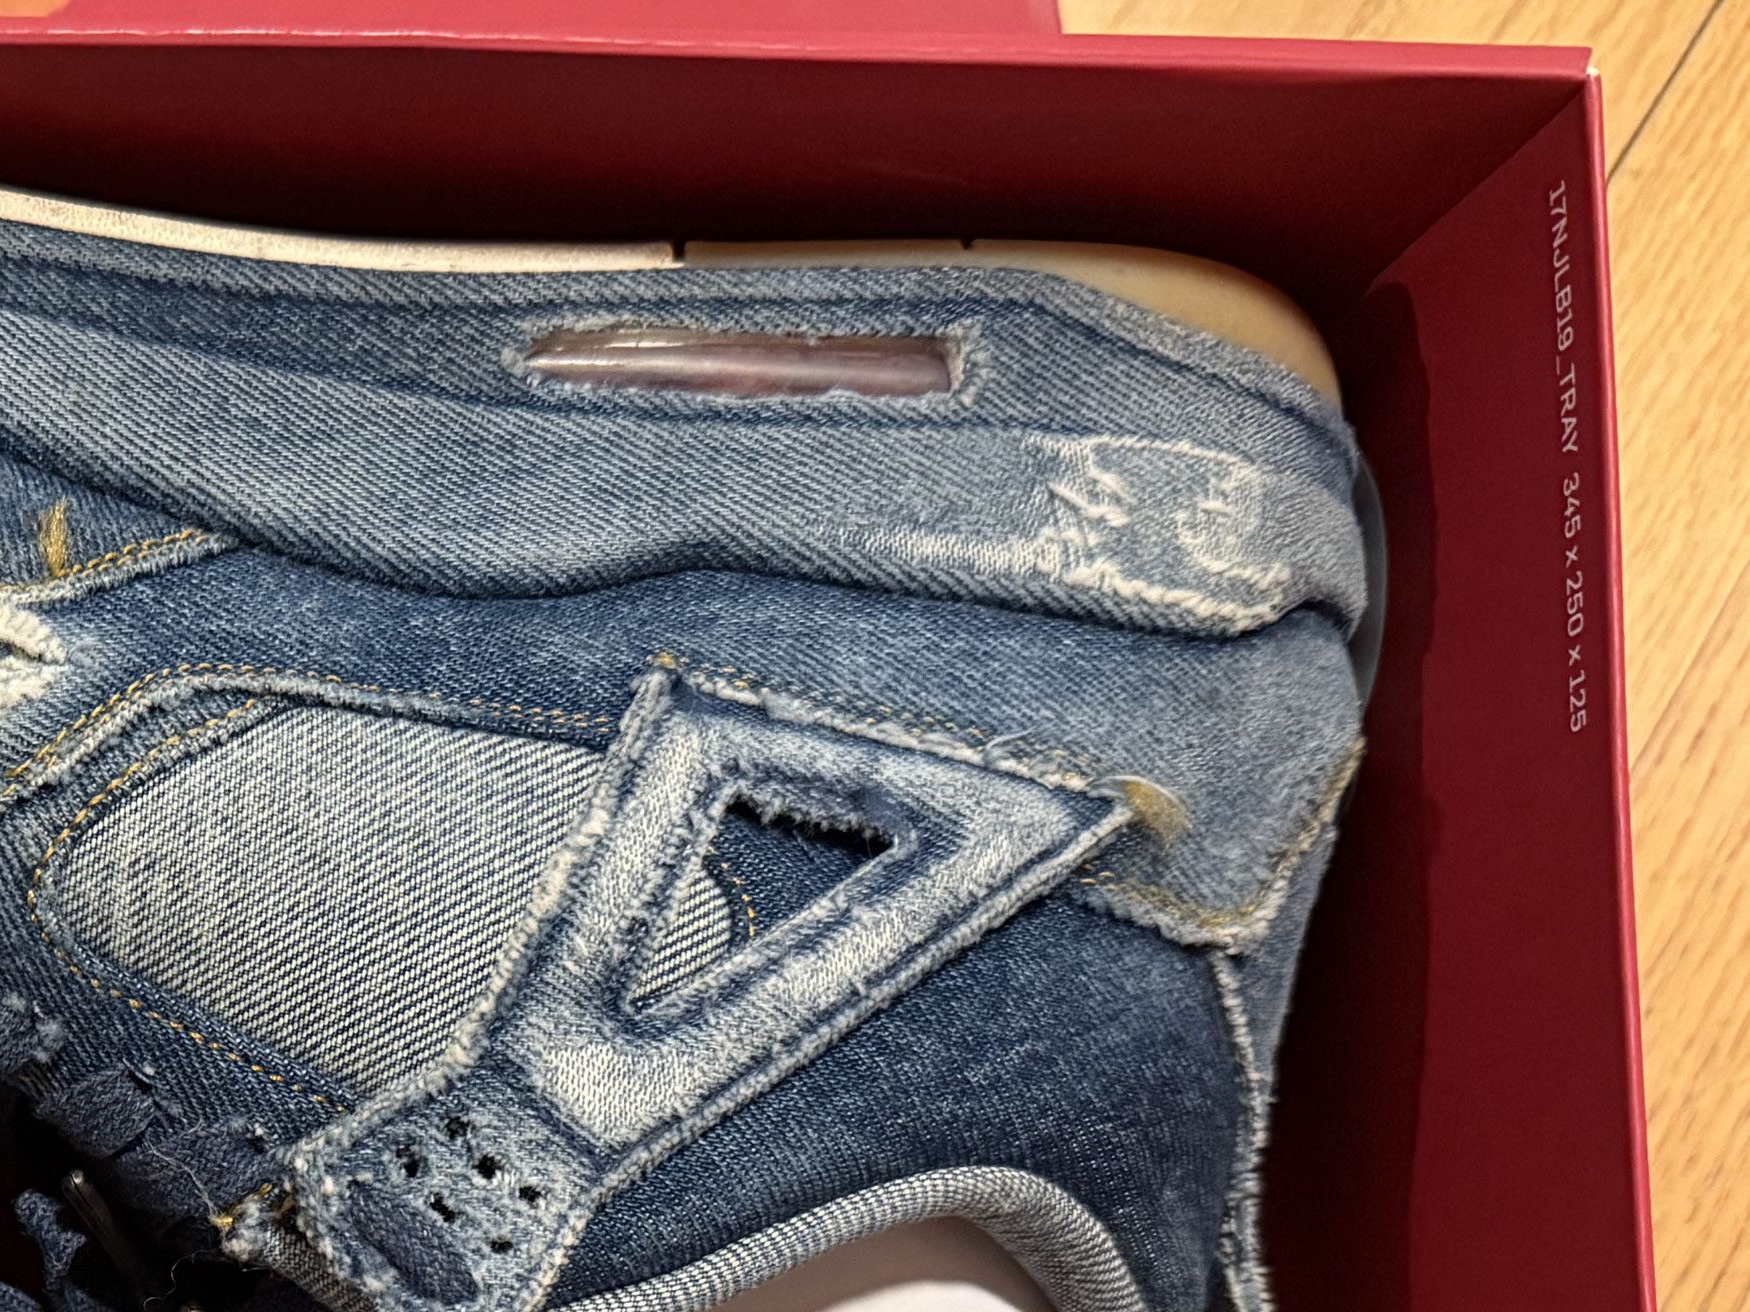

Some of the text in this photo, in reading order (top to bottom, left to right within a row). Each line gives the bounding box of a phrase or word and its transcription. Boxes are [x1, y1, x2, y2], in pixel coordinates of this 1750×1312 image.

[1549, 180, 1579, 453] 17NJLB19_TRAY
[1563, 472, 1581, 538] 345
[1566, 570, 1584, 638] 250
[1569, 670, 1587, 732] 125
